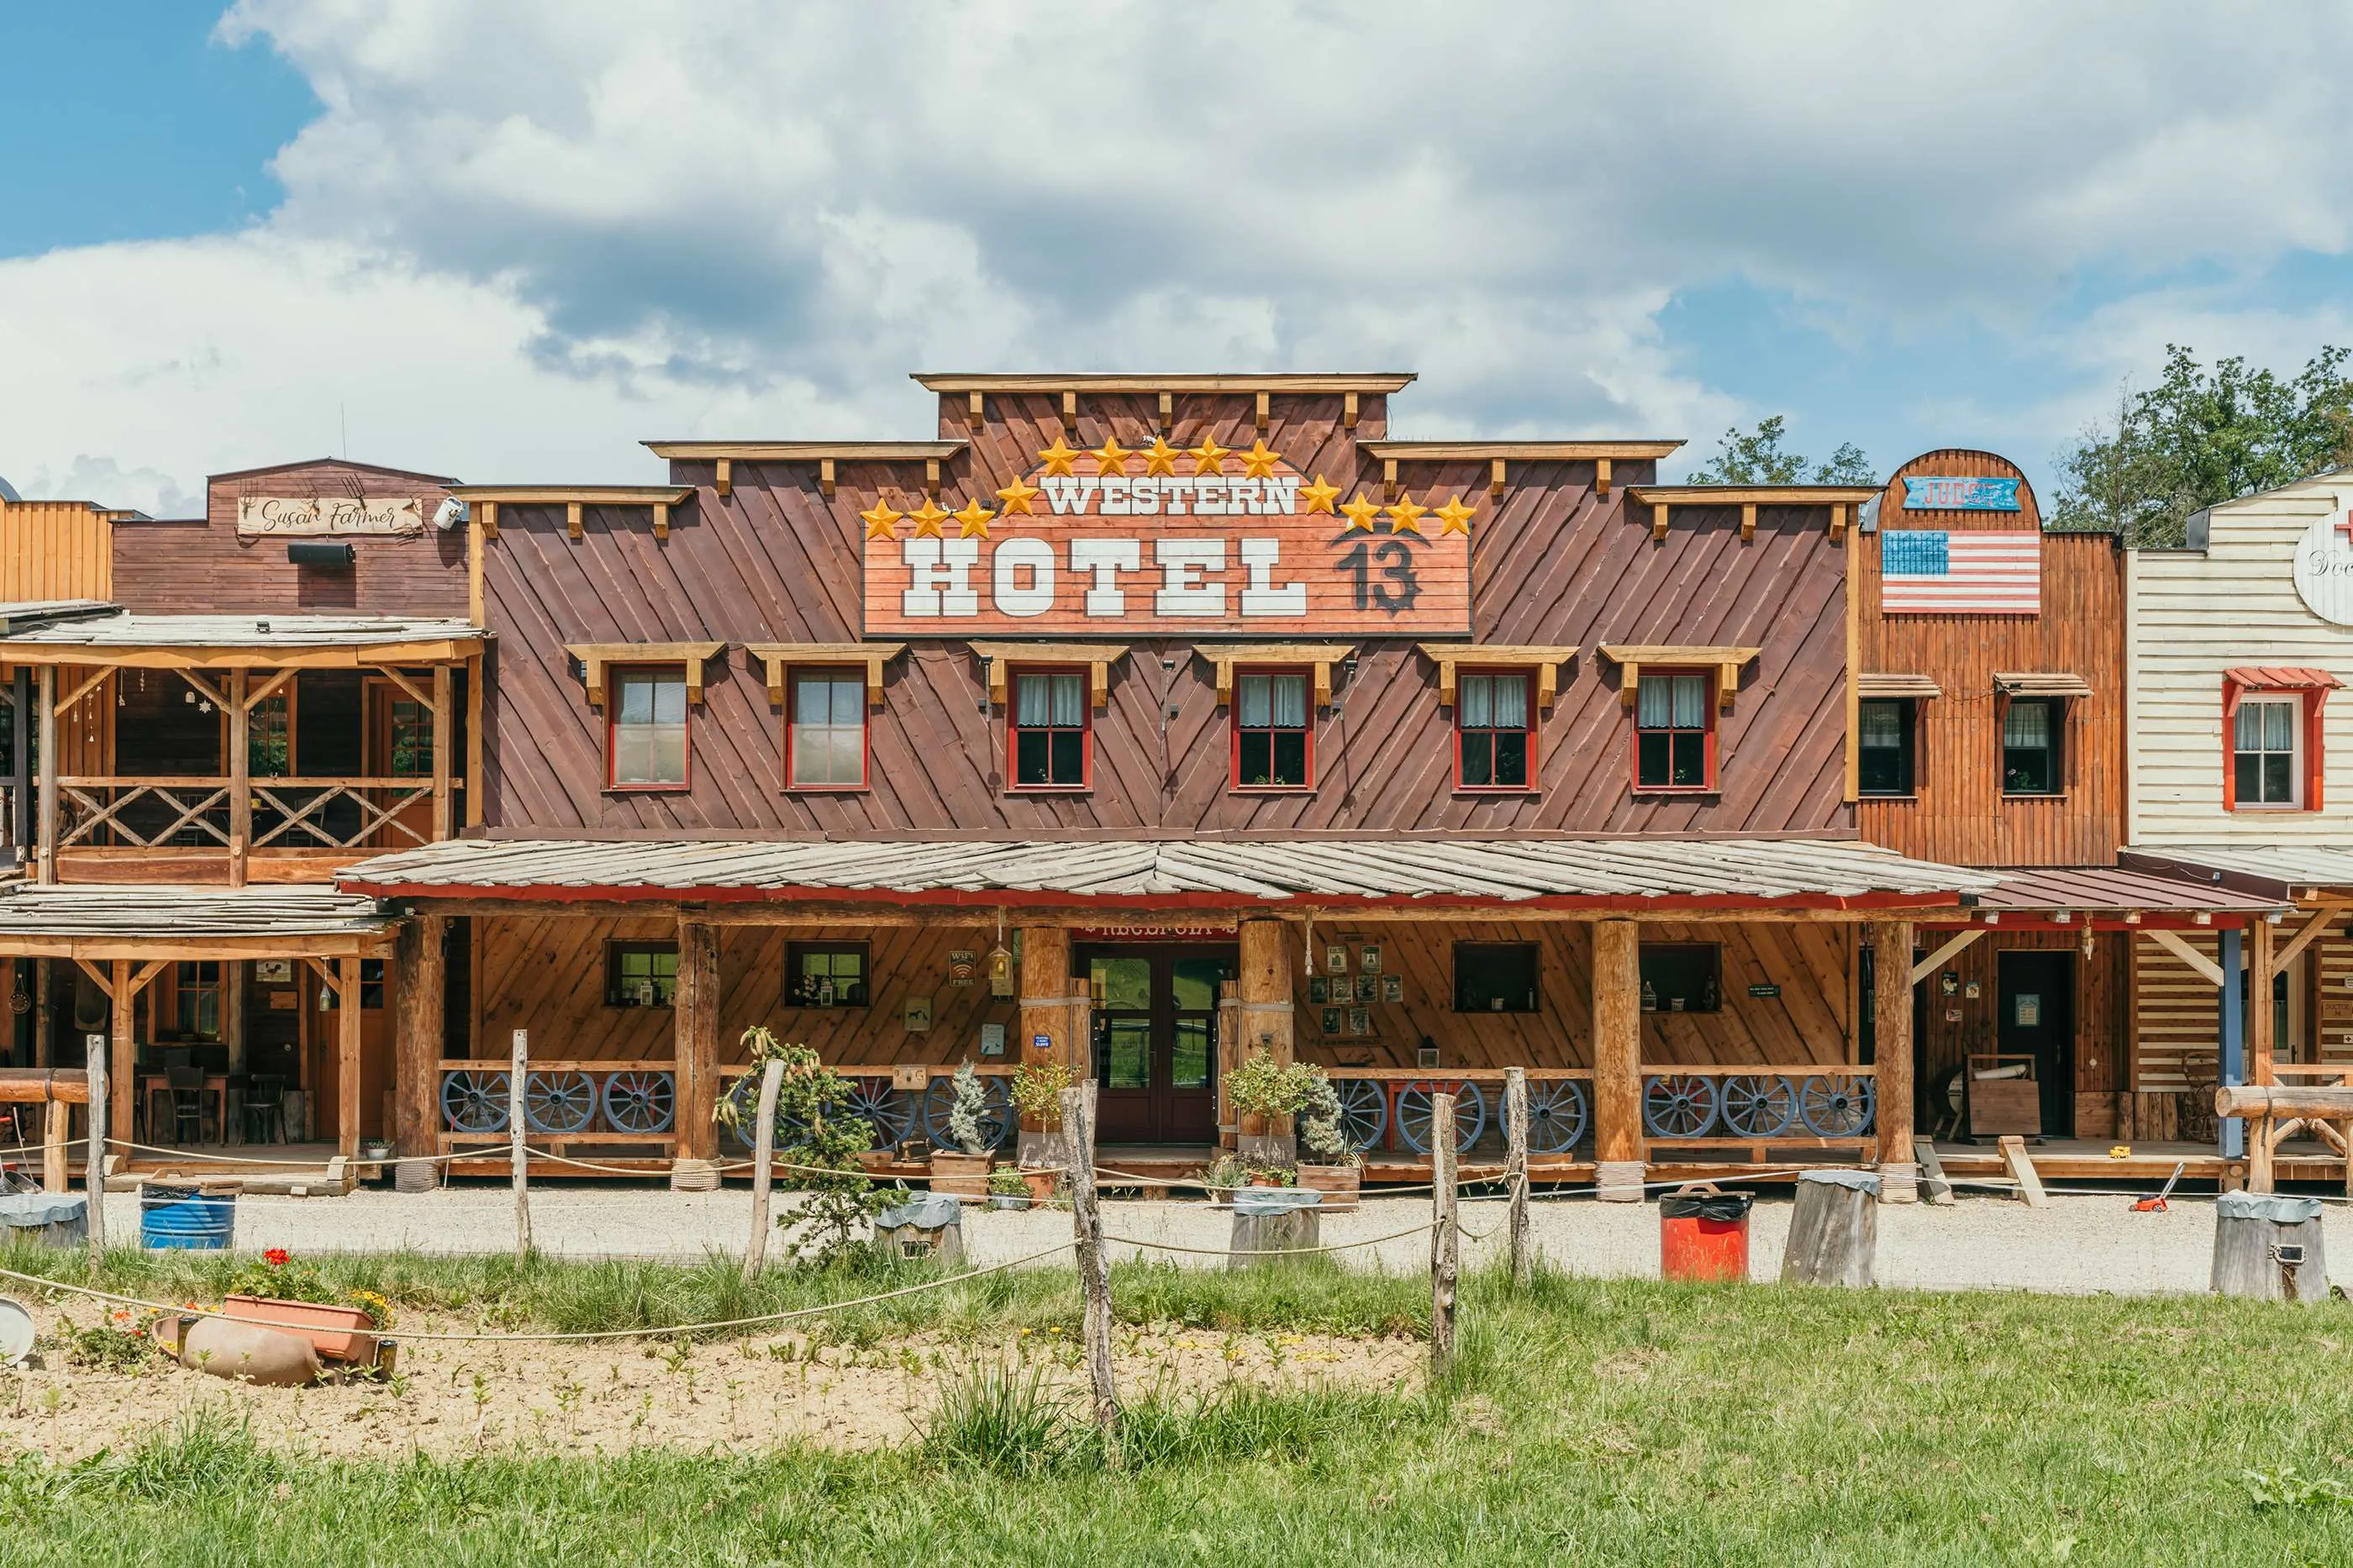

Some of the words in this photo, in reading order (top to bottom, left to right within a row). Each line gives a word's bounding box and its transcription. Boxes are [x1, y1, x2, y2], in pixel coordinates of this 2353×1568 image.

[1039, 476, 1300, 515] WESTERN
[261, 500, 322, 531] Susan
[330, 502, 396, 530] Farmer
[901, 537, 1307, 618] HOTEL
[1334, 541, 1424, 618] 13
